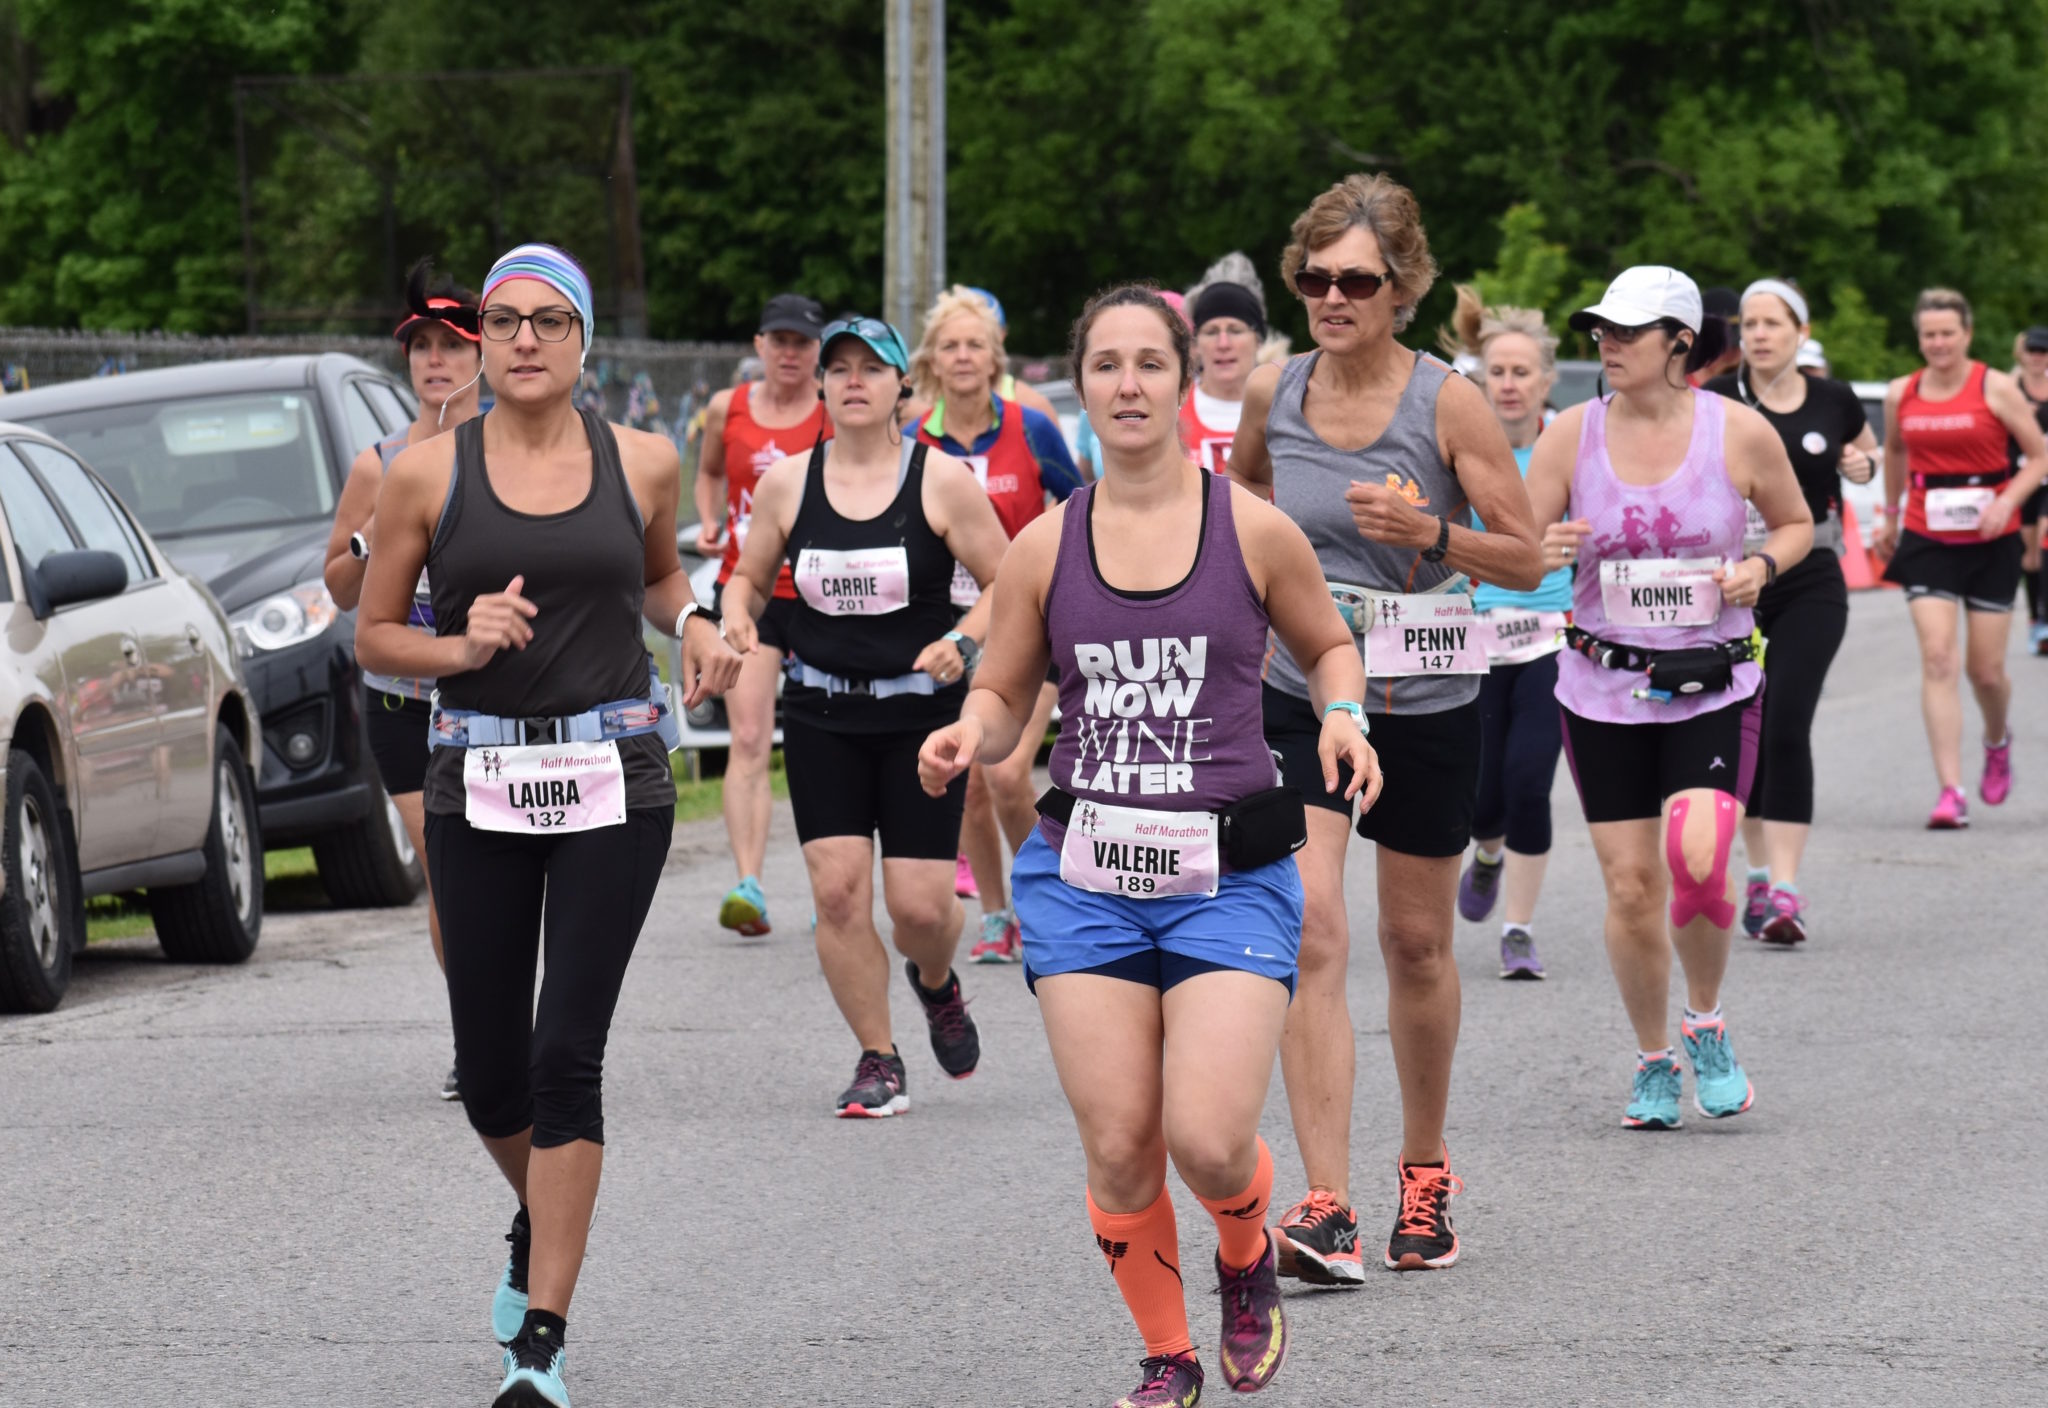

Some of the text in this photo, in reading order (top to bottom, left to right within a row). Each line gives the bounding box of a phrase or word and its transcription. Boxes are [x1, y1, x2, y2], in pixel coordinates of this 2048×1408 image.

[822, 577, 878, 597] CARRIE
[1631, 586, 1693, 608] KONNIE
[837, 599, 865, 611] 201
[1434, 606, 1453, 617] Half
[1648, 610, 1678, 622] 117
[1404, 626, 1467, 652] PENNY
[1496, 617, 1541, 640] SARAH
[1074, 636, 1207, 682] RUN
[1420, 655, 1454, 669] 147
[1084, 678, 1204, 719] NOW
[1077, 717, 1212, 763] WINE
[541, 754, 612, 769] Half Marathon
[1071, 758, 1195, 795] LATER
[508, 779, 581, 809] LAURA
[526, 811, 567, 827] 132
[1135, 823, 1209, 838] Half Marathon
[1093, 840, 1180, 876] VALERIE
[1115, 875, 1155, 894] 189
